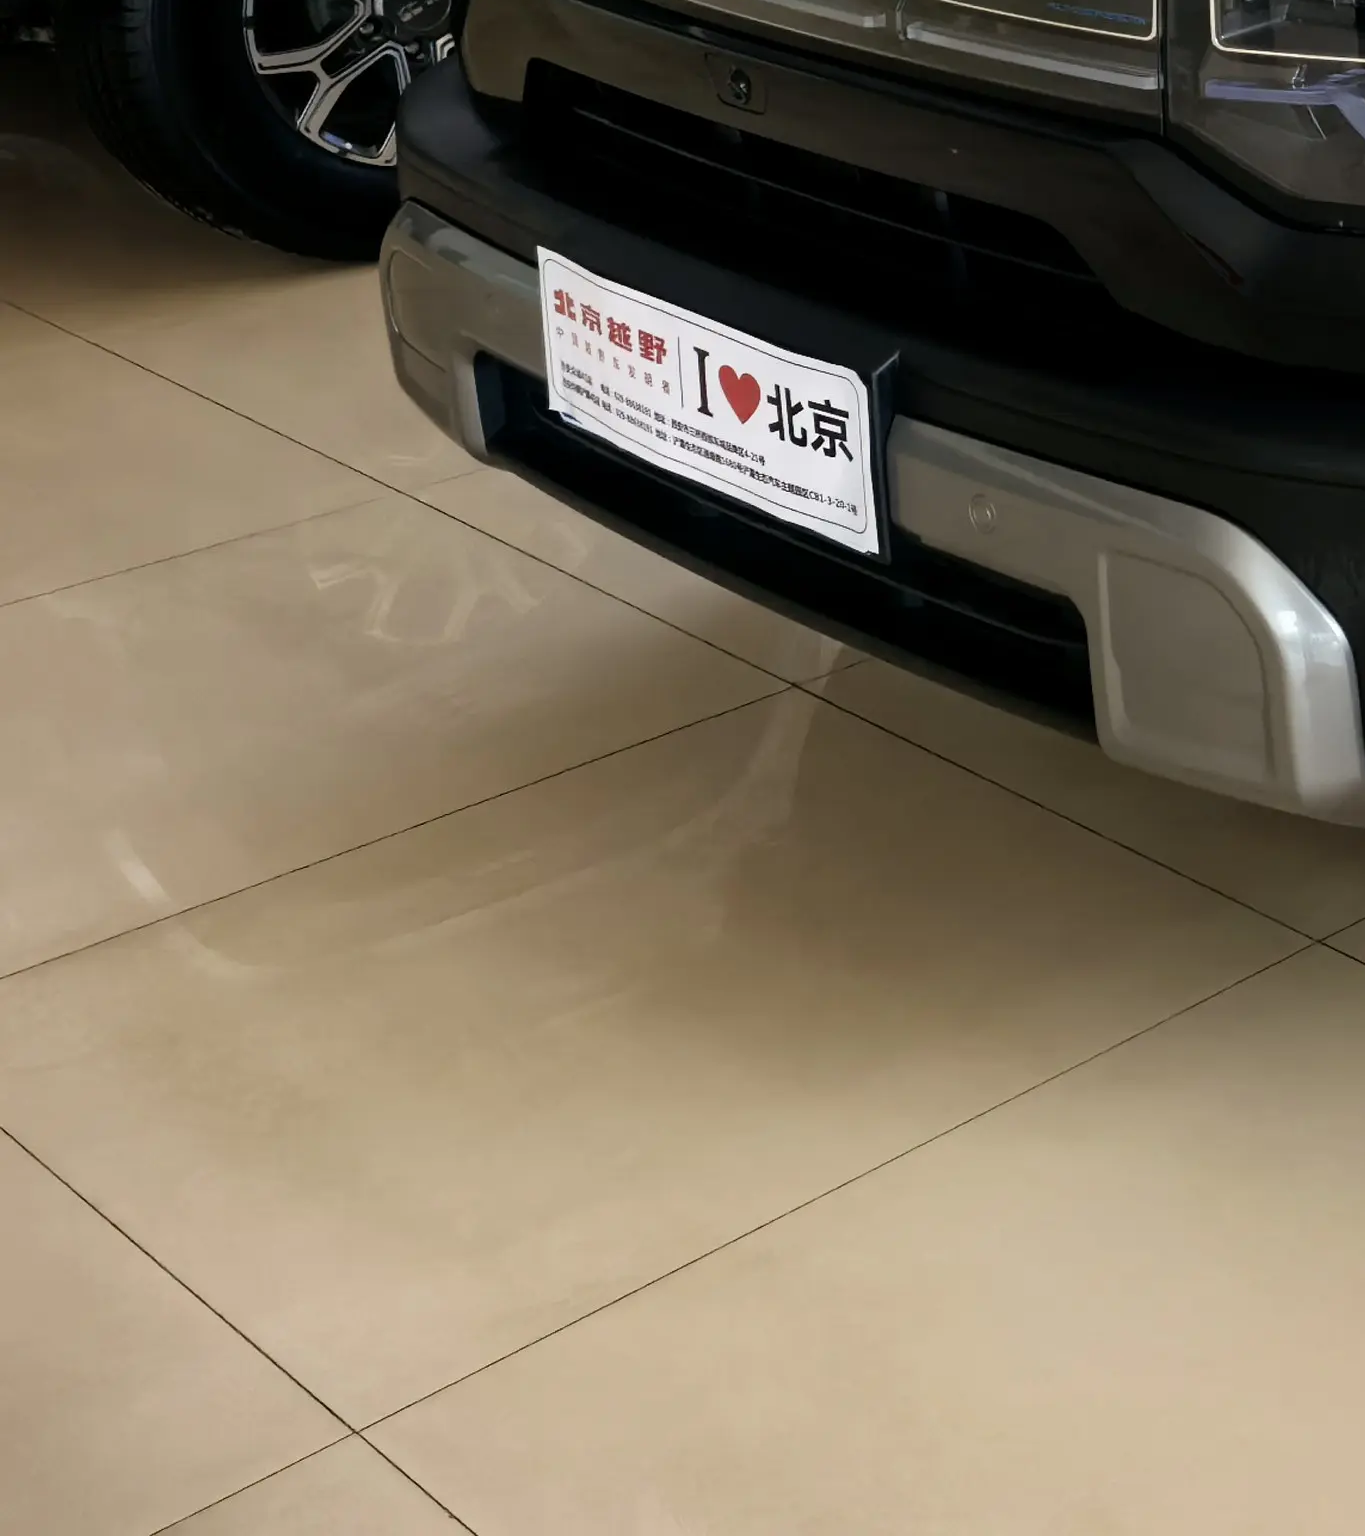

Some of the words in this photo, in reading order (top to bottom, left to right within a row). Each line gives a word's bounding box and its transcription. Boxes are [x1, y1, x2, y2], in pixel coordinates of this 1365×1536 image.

[553, 289, 667, 364] 北京越野
[693, 346, 714, 418] I
[766, 384, 854, 463] 北京
